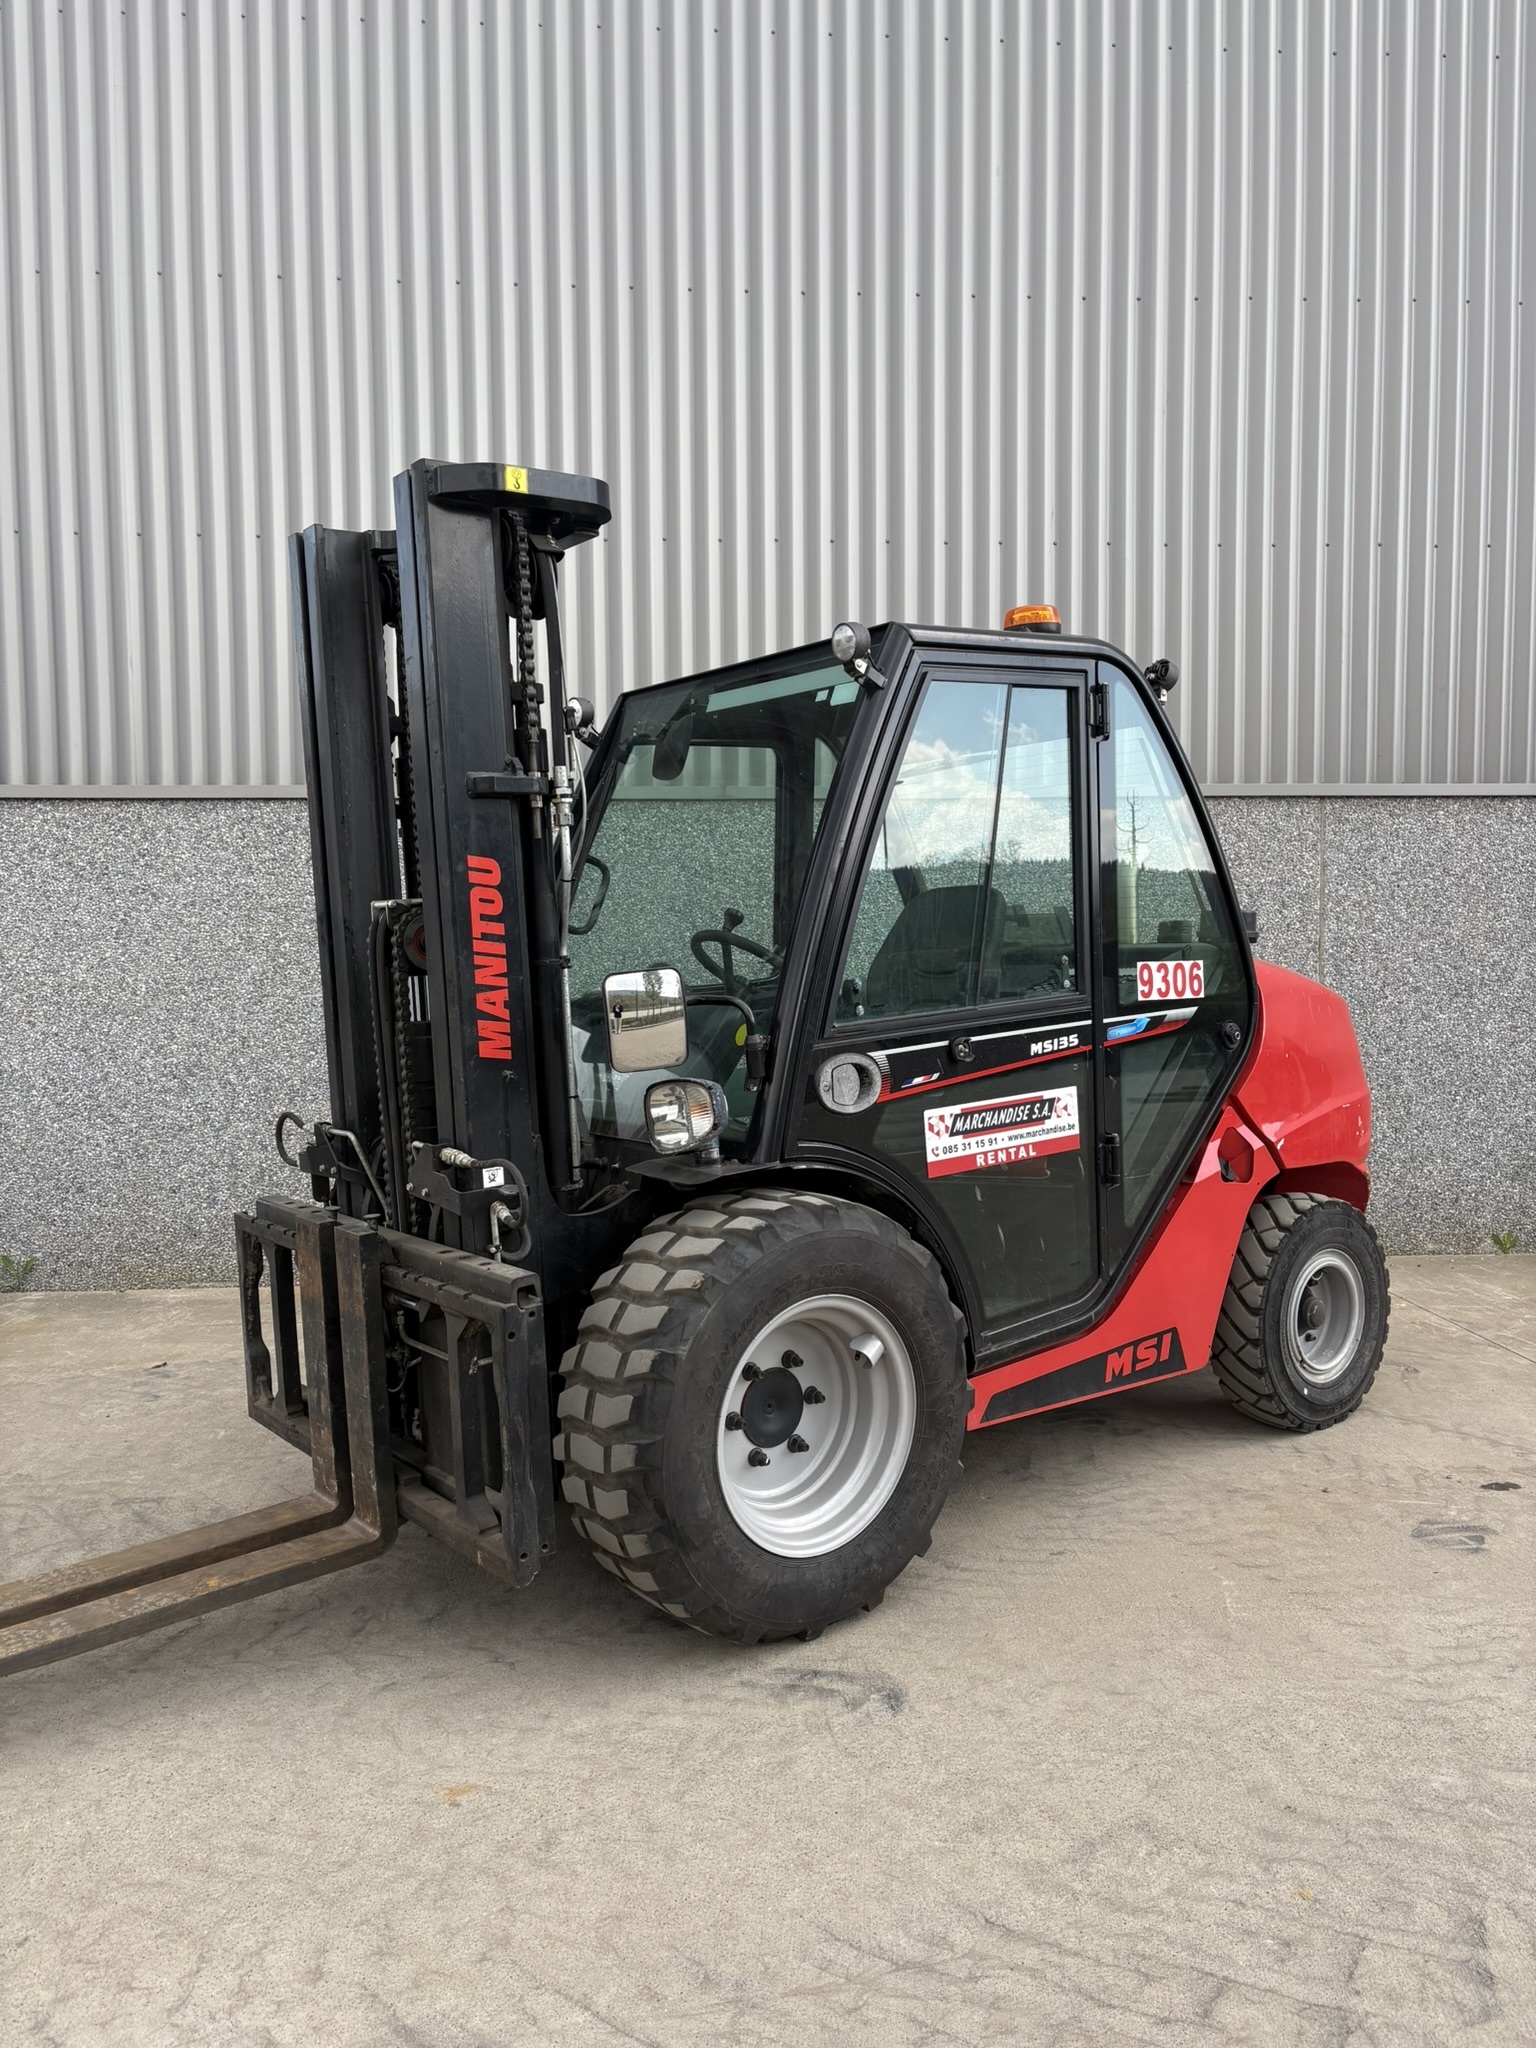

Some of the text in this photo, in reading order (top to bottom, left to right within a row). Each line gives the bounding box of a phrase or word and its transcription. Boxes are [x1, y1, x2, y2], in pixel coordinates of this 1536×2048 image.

[467, 854, 513, 1060] MANITOU
[1138, 962, 1203, 999] 9306
[1030, 1034, 1079, 1056] MSI35
[953, 1102, 1052, 1133] MARCHANDISE S.A.
[942, 1122, 1076, 1155] 085 31 15 91 www.marchandise.be
[976, 1144, 1037, 1167] RENTAL
[1105, 1331, 1173, 1384] MSI
